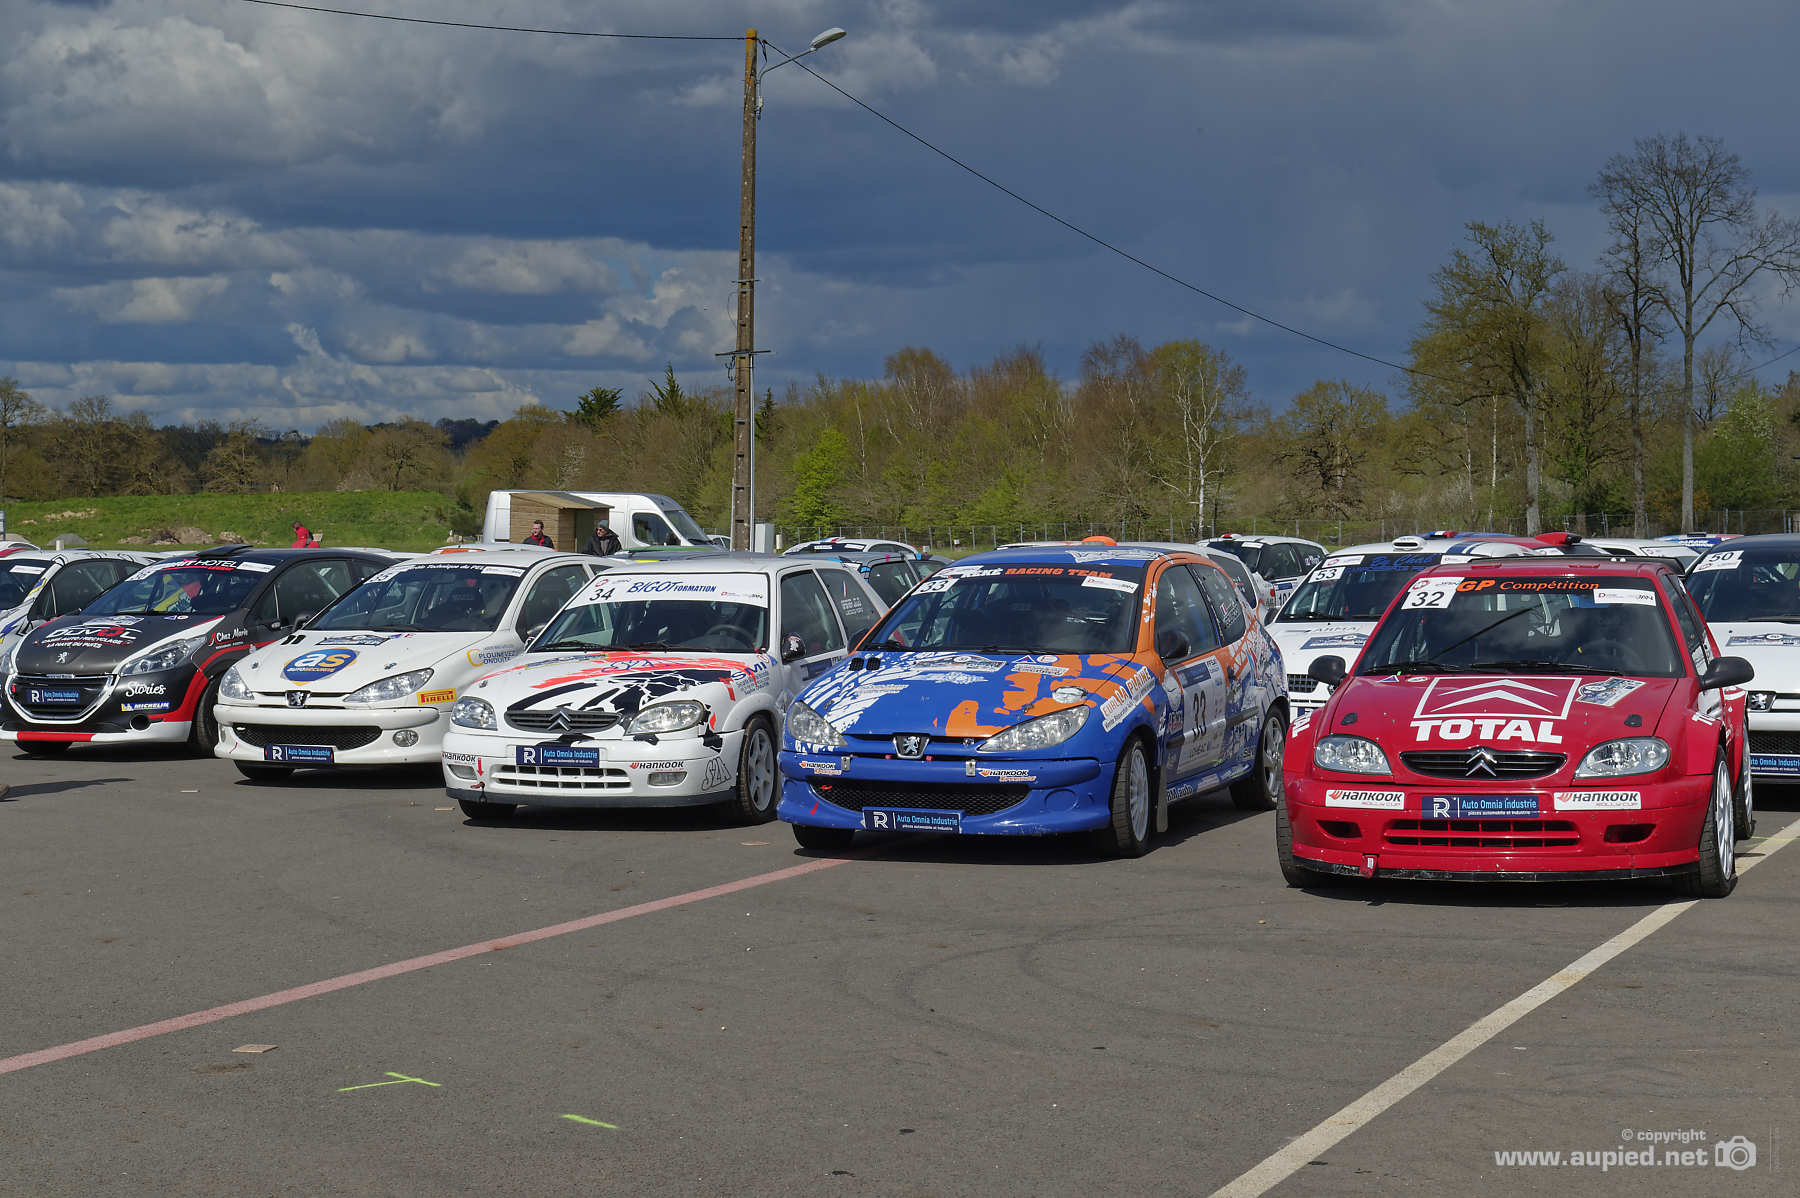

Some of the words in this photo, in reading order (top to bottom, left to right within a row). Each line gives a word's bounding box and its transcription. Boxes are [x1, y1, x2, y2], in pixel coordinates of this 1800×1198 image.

[195, 559, 238, 569] HOTEL
[1708, 551, 1734, 563] 50
[1004, 567, 1065, 577] RACING
[1067, 568, 1113, 579] TEAM
[1315, 568, 1338, 581] 53
[626, 580, 684, 594] BIGOT
[673, 584, 717, 593] FORMATION
[919, 579, 948, 593] 33
[1456, 579, 1497, 593] GP
[1499, 579, 1600, 592] Compétition
[588, 587, 616, 601] 34
[1410, 591, 1446, 608] 32
[294, 653, 351, 668] as
[125, 681, 167, 697] Stories
[420, 690, 454, 704] PIRELLI
[133, 701, 170, 710] MICHELIN
[1192, 690, 1207, 739] 33
[1409, 718, 1564, 745] TOTAL
[544, 749, 556, 758] Auto
[556, 750, 573, 758] Omnia
[573, 750, 598, 759] Industrie
[1759, 757, 1777, 766] Omnia
[1778, 757, 1800, 767] Industri
[1433, 797, 1451, 818] R
[1461, 799, 1479, 809] Auto
[1480, 799, 1503, 809] Omnia
[1504, 799, 1538, 809] Industrie
[896, 814, 911, 824] Auto
[911, 815, 930, 825] Omnia
[931, 816, 959, 826] Industrie
